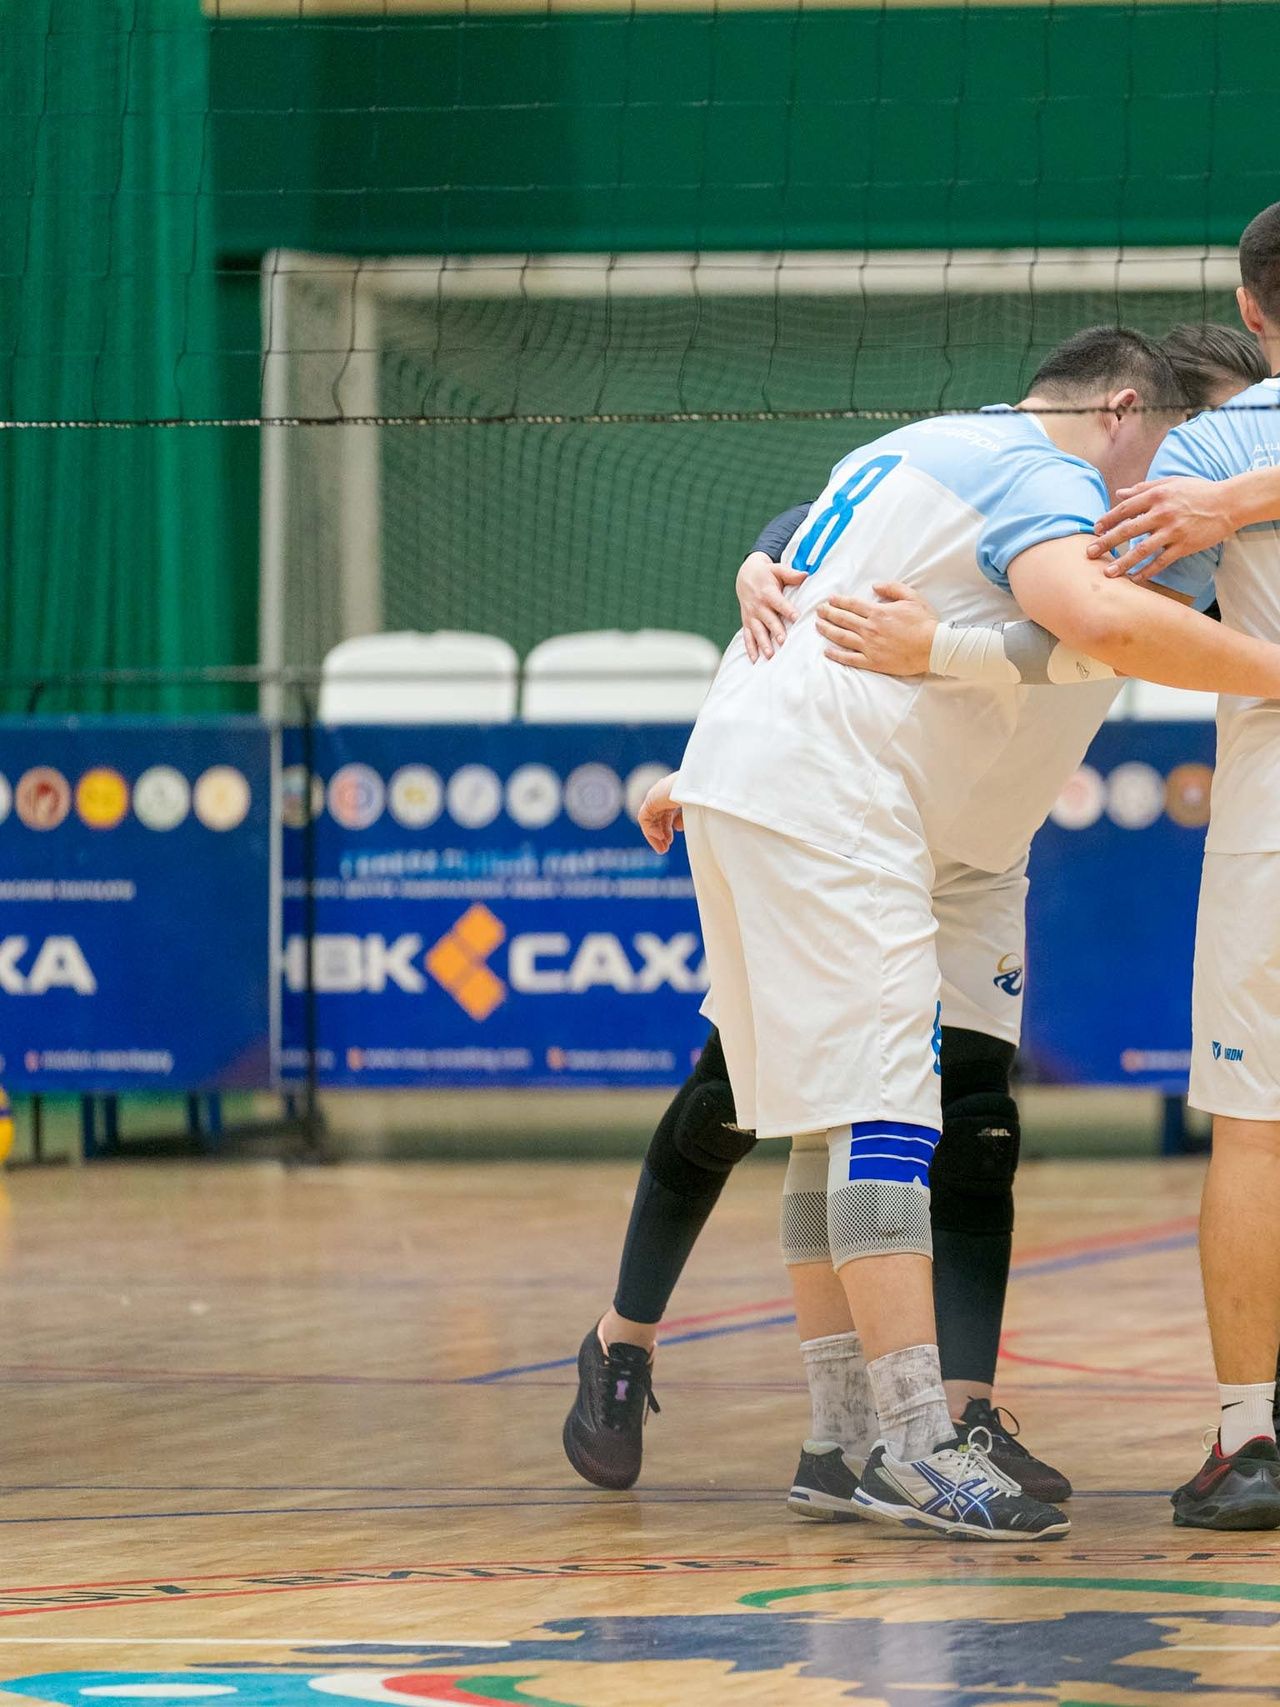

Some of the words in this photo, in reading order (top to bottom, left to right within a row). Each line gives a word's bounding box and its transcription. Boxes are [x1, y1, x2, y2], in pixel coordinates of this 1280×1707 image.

[791, 453, 904, 576] 8
[508, 933, 713, 994] САХ
[237, 1559, 779, 1586] ВИДОВ
